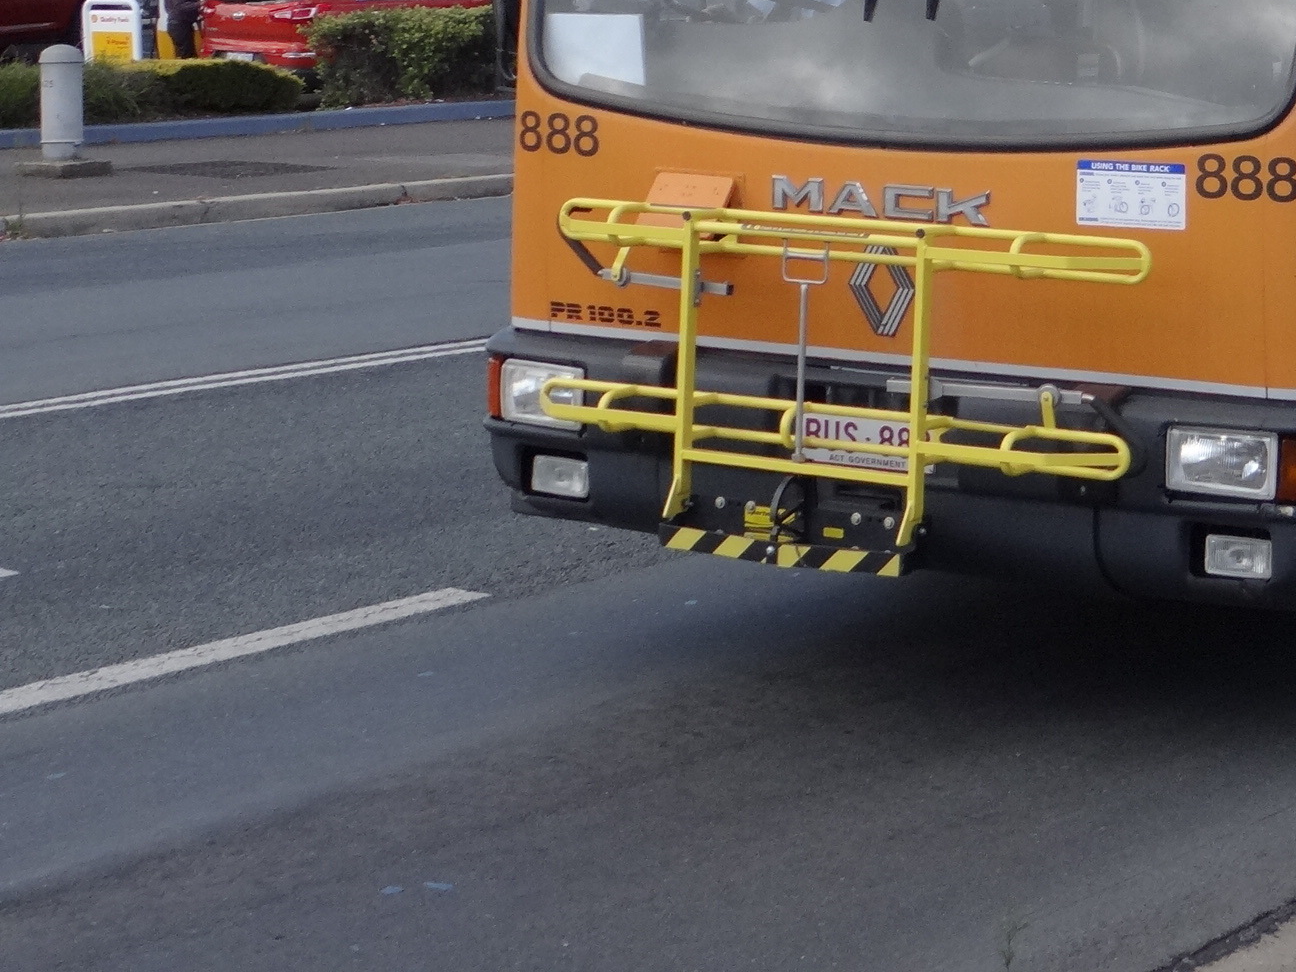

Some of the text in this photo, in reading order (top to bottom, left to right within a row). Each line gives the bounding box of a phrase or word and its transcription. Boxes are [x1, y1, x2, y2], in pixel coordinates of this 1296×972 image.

[519, 110, 600, 157] 888
[1091, 162, 1114, 170] USING
[1131, 164, 1147, 172] BIKE
[1149, 165, 1170, 173] RACK
[772, 174, 990, 227] MACK
[879, 425, 931, 447] 88
[829, 454, 906, 468] ACT GOVERNMENT
